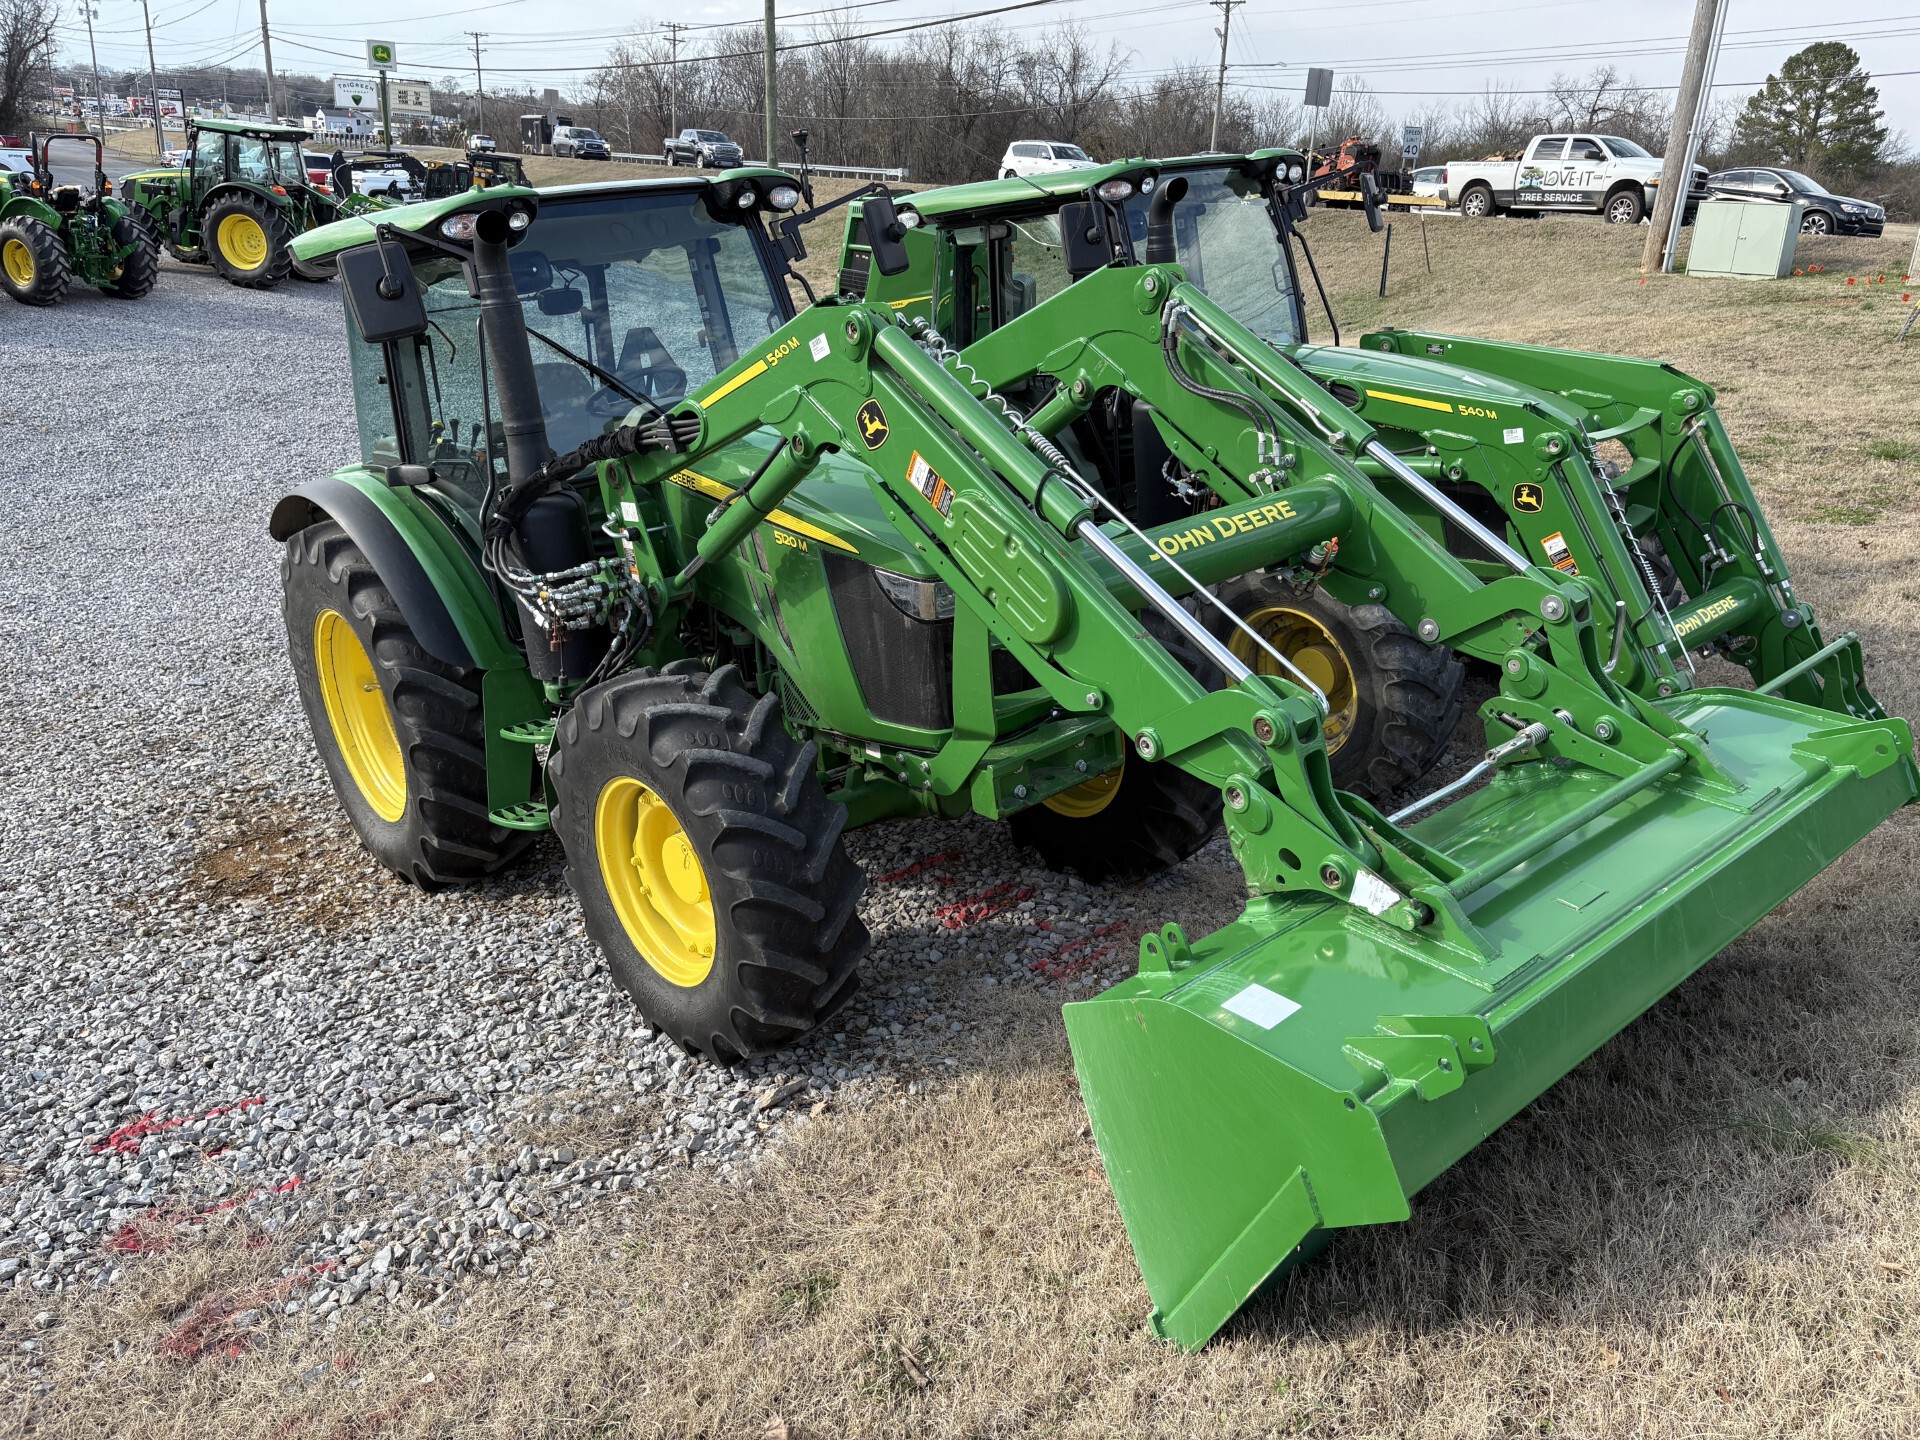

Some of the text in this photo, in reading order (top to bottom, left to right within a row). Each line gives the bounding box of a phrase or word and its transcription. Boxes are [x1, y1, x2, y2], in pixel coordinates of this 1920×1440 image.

[1404, 144, 1418, 156] 40
[1543, 170, 1596, 187] LOVE-IT
[1520, 192, 1583, 203] TREE SERVICE
[765, 344, 790, 367] 540
[787, 336, 801, 350] M
[1458, 404, 1498, 420] 540 M
[1210, 500, 1297, 538] DEERE
[774, 530, 809, 553] 5120 M
[1673, 595, 1739, 641] OHN DEERE
